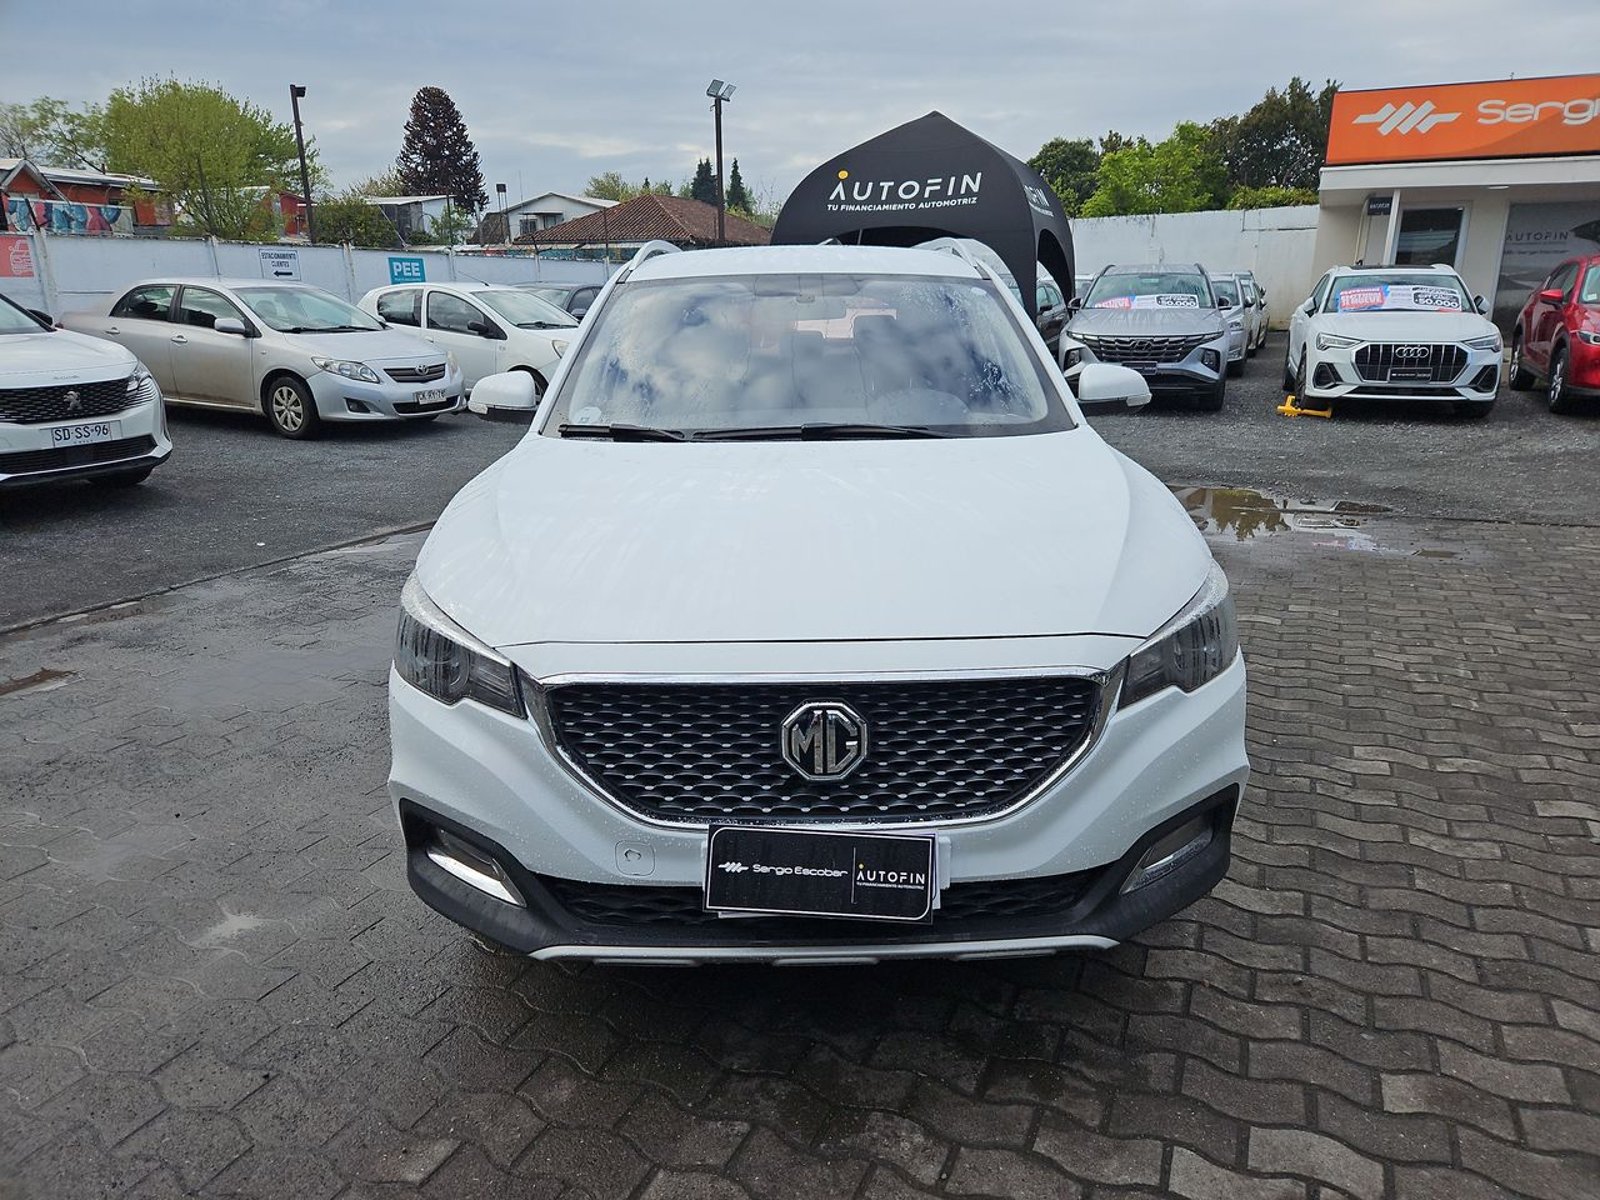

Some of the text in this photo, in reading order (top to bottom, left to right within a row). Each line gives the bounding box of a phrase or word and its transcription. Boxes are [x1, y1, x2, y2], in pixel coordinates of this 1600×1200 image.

[1478, 97, 1600, 125] Serg
[829, 172, 982, 201] AUTOFIN
[840, 202, 916, 212] FINANCIAMIENTO
[918, 197, 978, 210] AUTOMOTRIZ
[1505, 231, 1569, 241] AUTOFIN
[271, 260, 290, 268] CLIENTES
[393, 262, 421, 277] PEE
[791, 709, 859, 774] MG
[752, 863, 849, 878] Sergo Escobar
[856, 869, 926, 885] AUTOFIN
